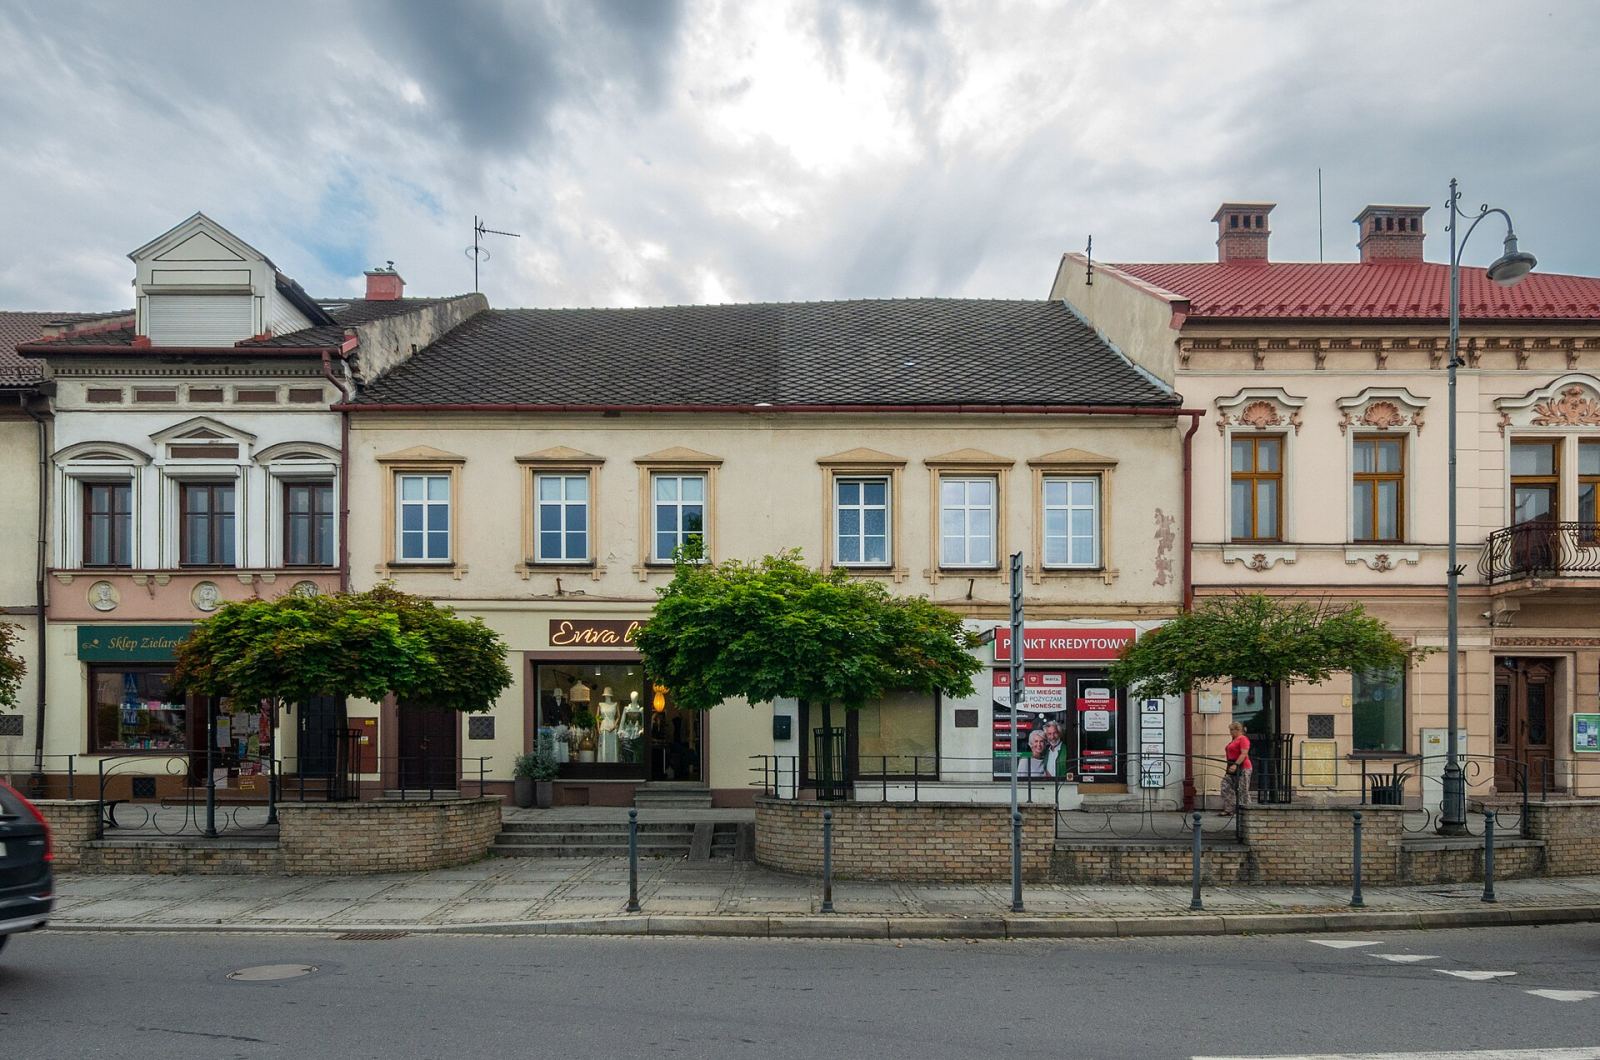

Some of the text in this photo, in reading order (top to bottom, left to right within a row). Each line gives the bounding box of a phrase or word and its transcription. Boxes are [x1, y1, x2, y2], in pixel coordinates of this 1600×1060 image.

[551, 621, 620, 645] Eviva
[107, 635, 185, 651] Sklep Zielarsk
[1003, 638, 1128, 649] PNKT KREDYTOWY
